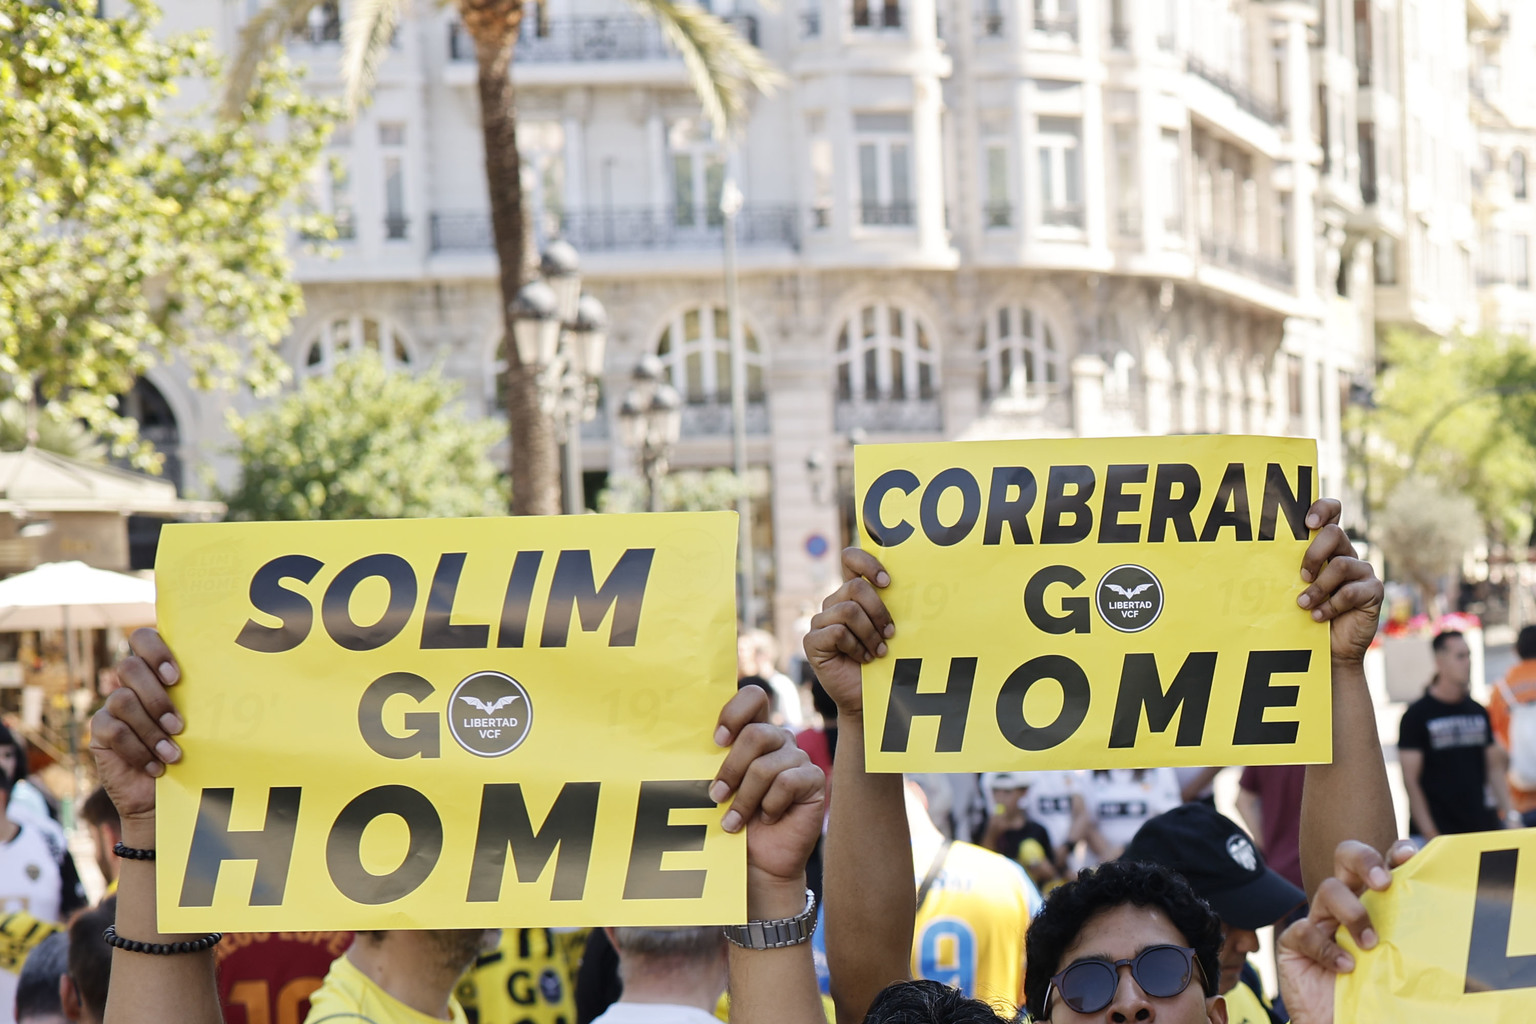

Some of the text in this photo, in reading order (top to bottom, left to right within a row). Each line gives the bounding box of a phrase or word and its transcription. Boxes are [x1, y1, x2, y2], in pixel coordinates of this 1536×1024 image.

[862, 463, 1312, 548] CORBERAN
[236, 548, 656, 653] SOLIM
[1108, 600, 1153, 610] LIBERTAD
[1121, 611, 1139, 619] VCF
[463, 717, 519, 728] LIBERTAD
[880, 650, 1312, 753] HOME
[479, 729, 502, 739] VCF
[179, 780, 719, 908] HOME
